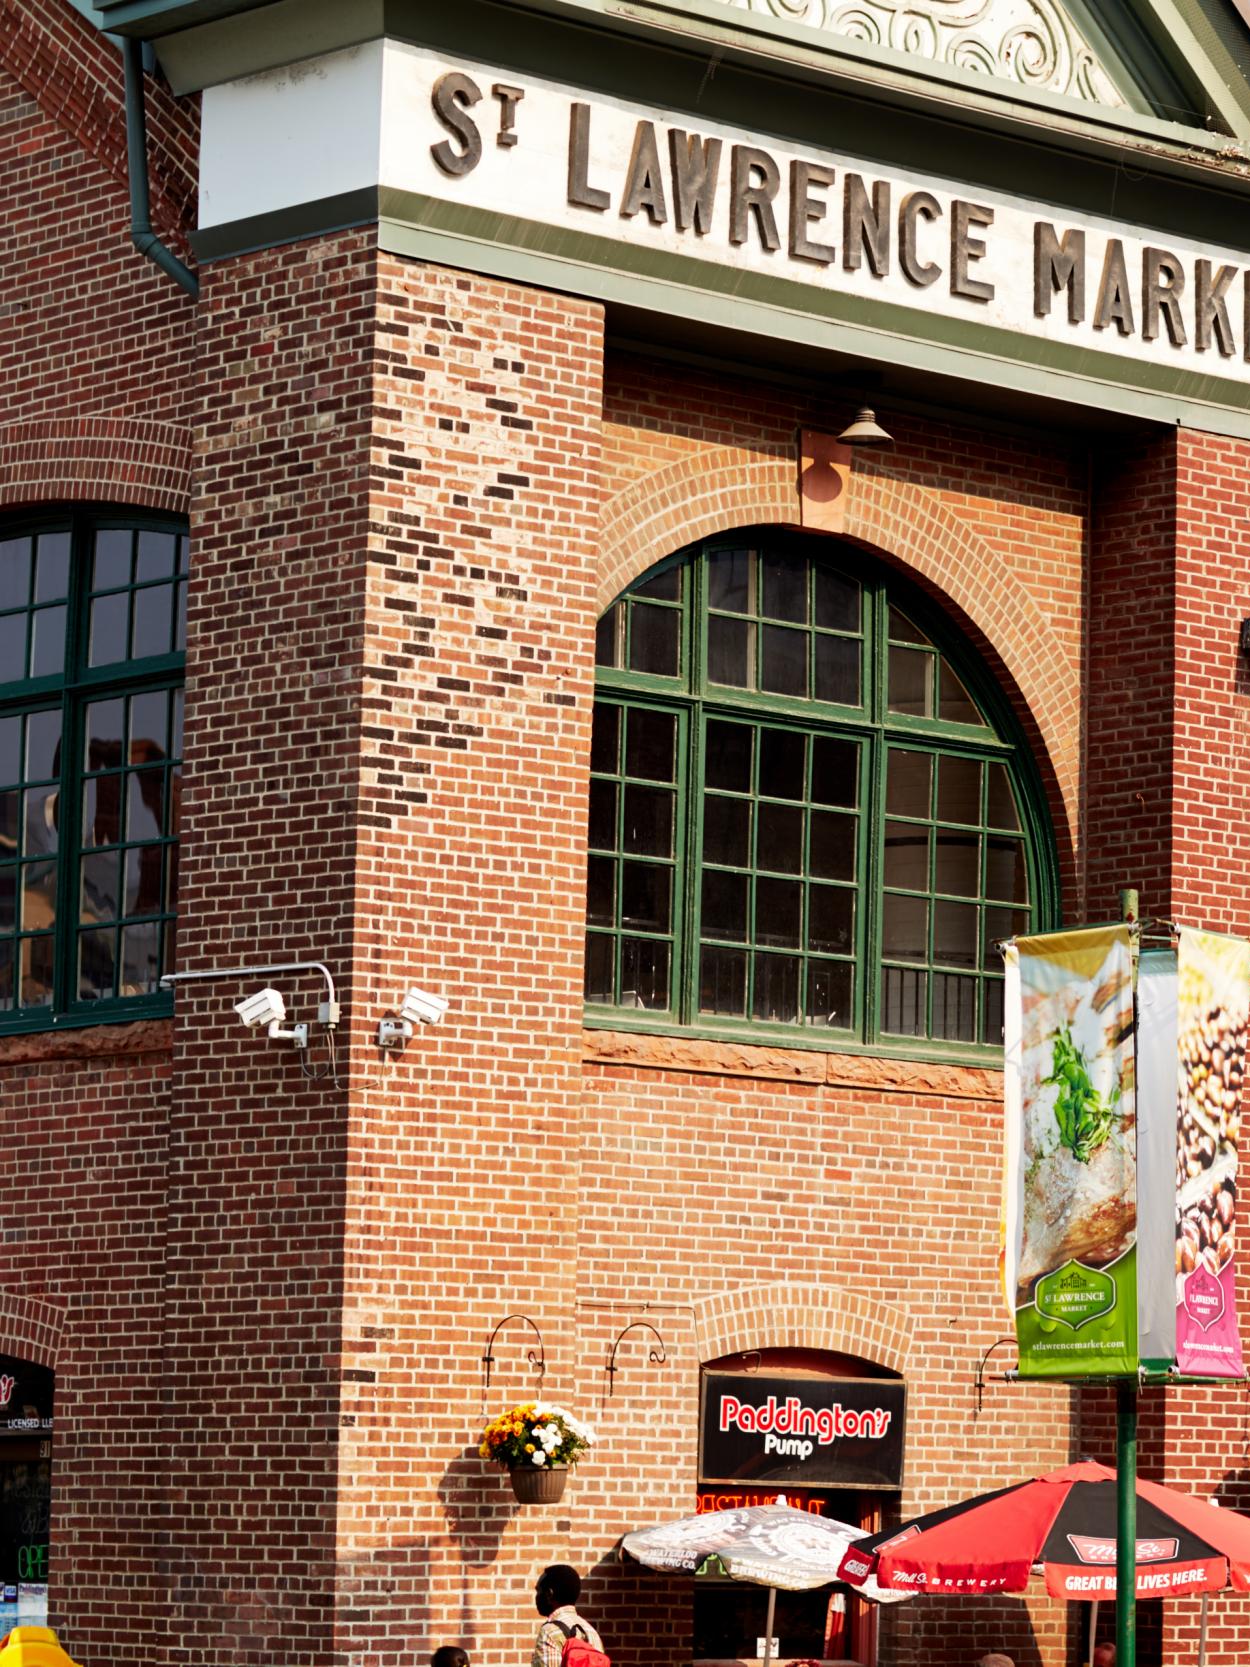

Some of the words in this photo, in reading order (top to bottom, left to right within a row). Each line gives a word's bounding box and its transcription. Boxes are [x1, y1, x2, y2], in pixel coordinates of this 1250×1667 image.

[566, 102, 994, 301] LAWRENCE
[1053, 1292, 1105, 1302] LAWRENCE
[1032, 1339, 1124, 1351] stlawrencemarket.com
[7, 1418, 40, 1429] LICENSED
[720, 1395, 891, 1445] Paddington's
[764, 1434, 814, 1460] Pump
[931, 1578, 1006, 1588] BREWERY
[1065, 1575, 1104, 1591] GREAT
[1136, 1573, 1171, 1590] LIVES
[1171, 1568, 1208, 1587] HERE.
